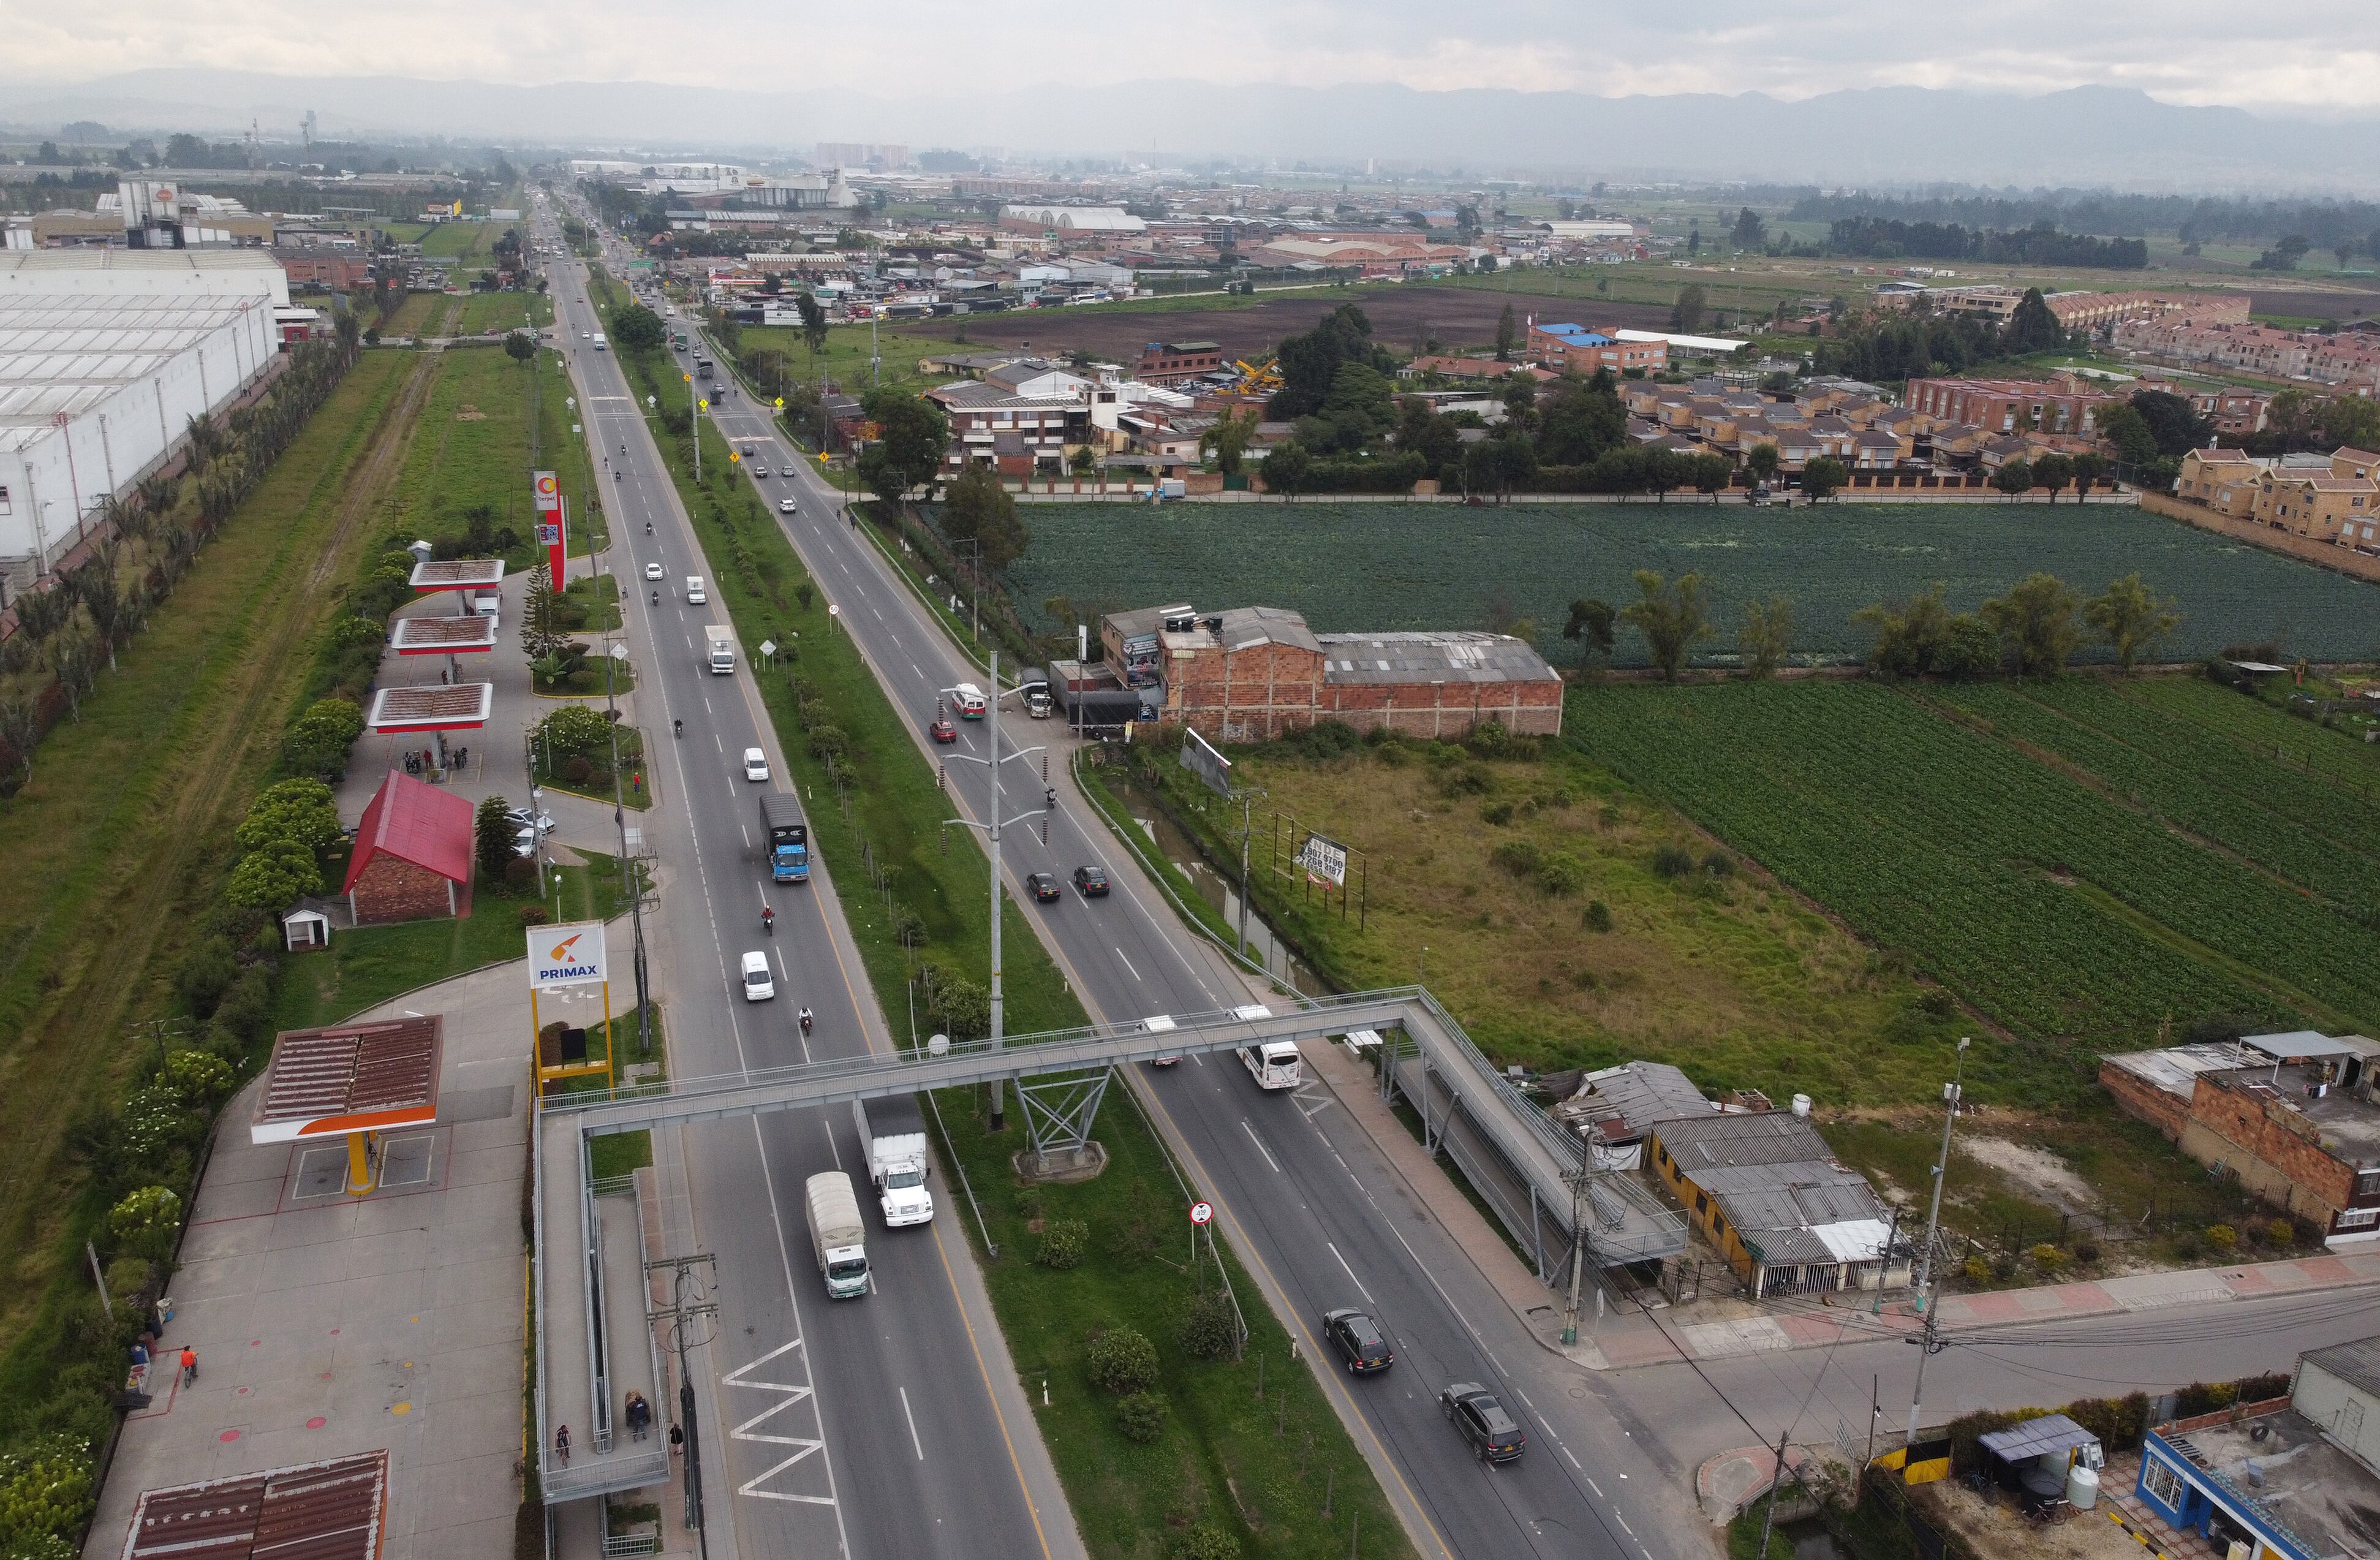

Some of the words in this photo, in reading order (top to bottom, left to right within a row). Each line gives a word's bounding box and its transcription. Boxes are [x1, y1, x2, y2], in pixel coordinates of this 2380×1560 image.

[1307, 855, 1322, 868] 268
[1323, 854, 1343, 869] 9700
[540, 964, 597, 980] PRIMAX
